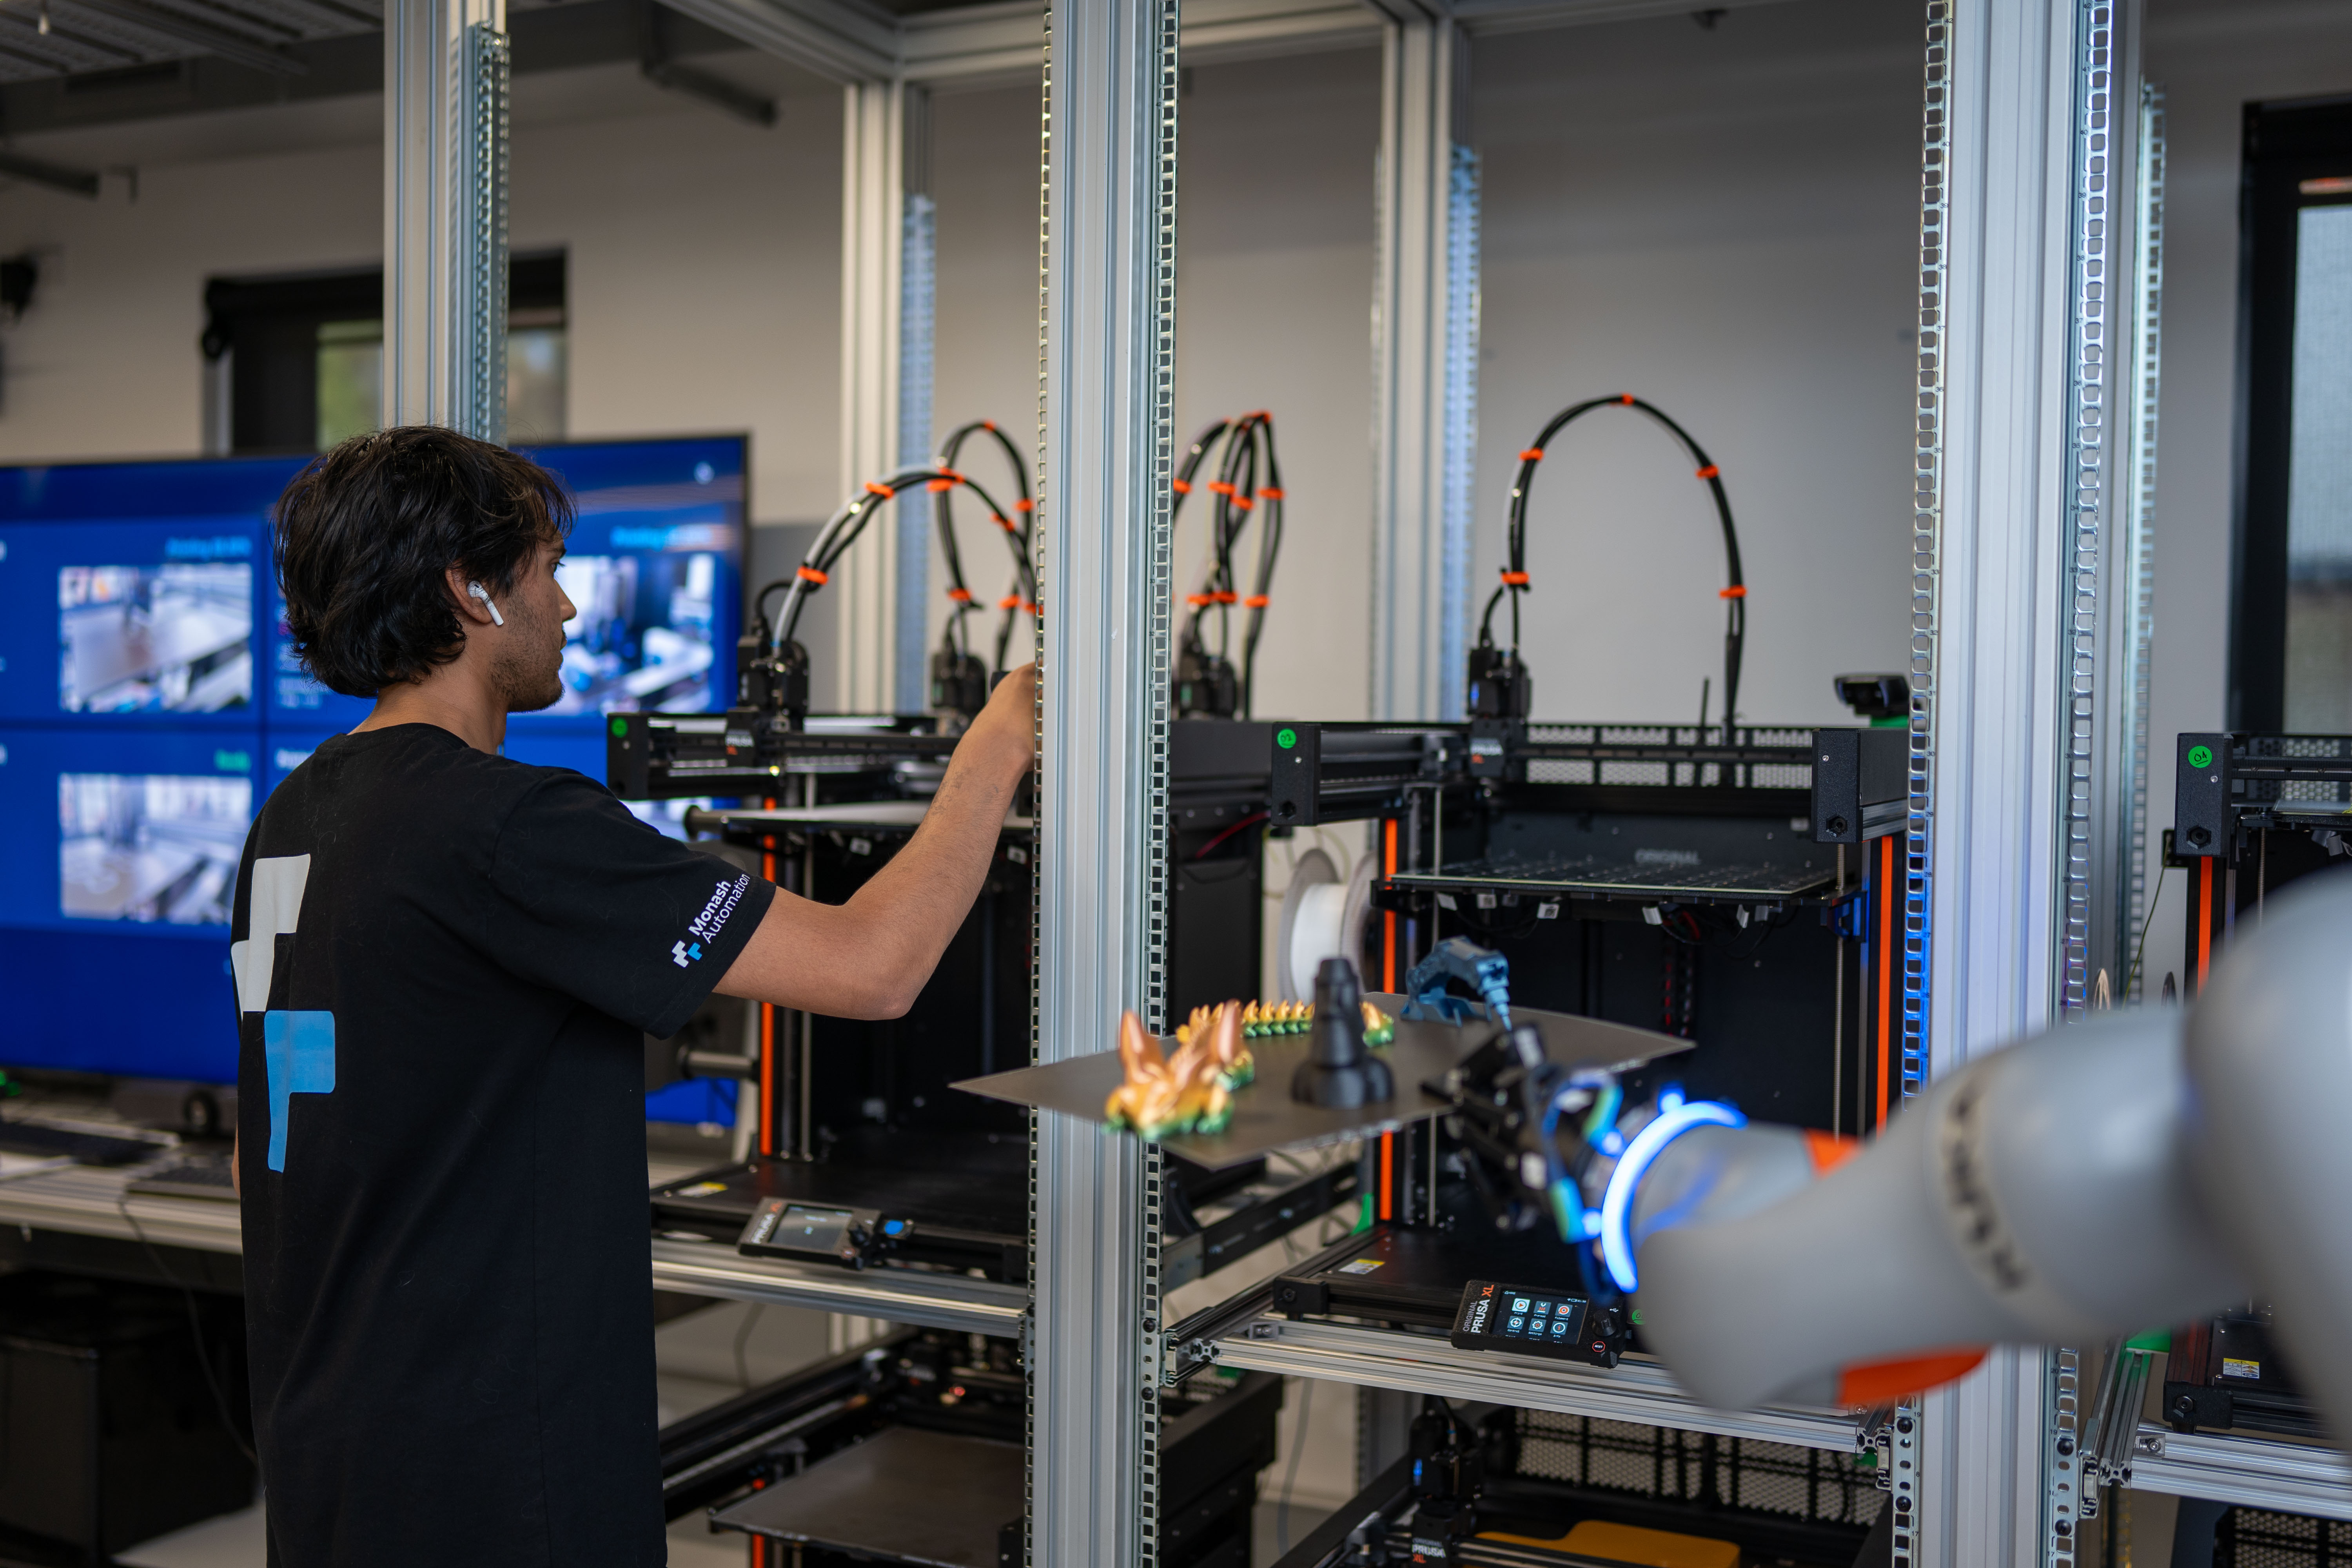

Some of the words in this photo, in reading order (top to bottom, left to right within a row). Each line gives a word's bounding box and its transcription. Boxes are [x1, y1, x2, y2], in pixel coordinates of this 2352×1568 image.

[2194, 751, 2207, 762] 04
[688, 880, 731, 936] Monash
[702, 874, 750, 944] Automation
[1463, 1301, 1478, 1332] ORIGINAL
[1470, 1299, 1490, 1333] PRUSA
[1481, 1285, 1494, 1297] XL
[1412, 1544, 1446, 1558] PRUSA
